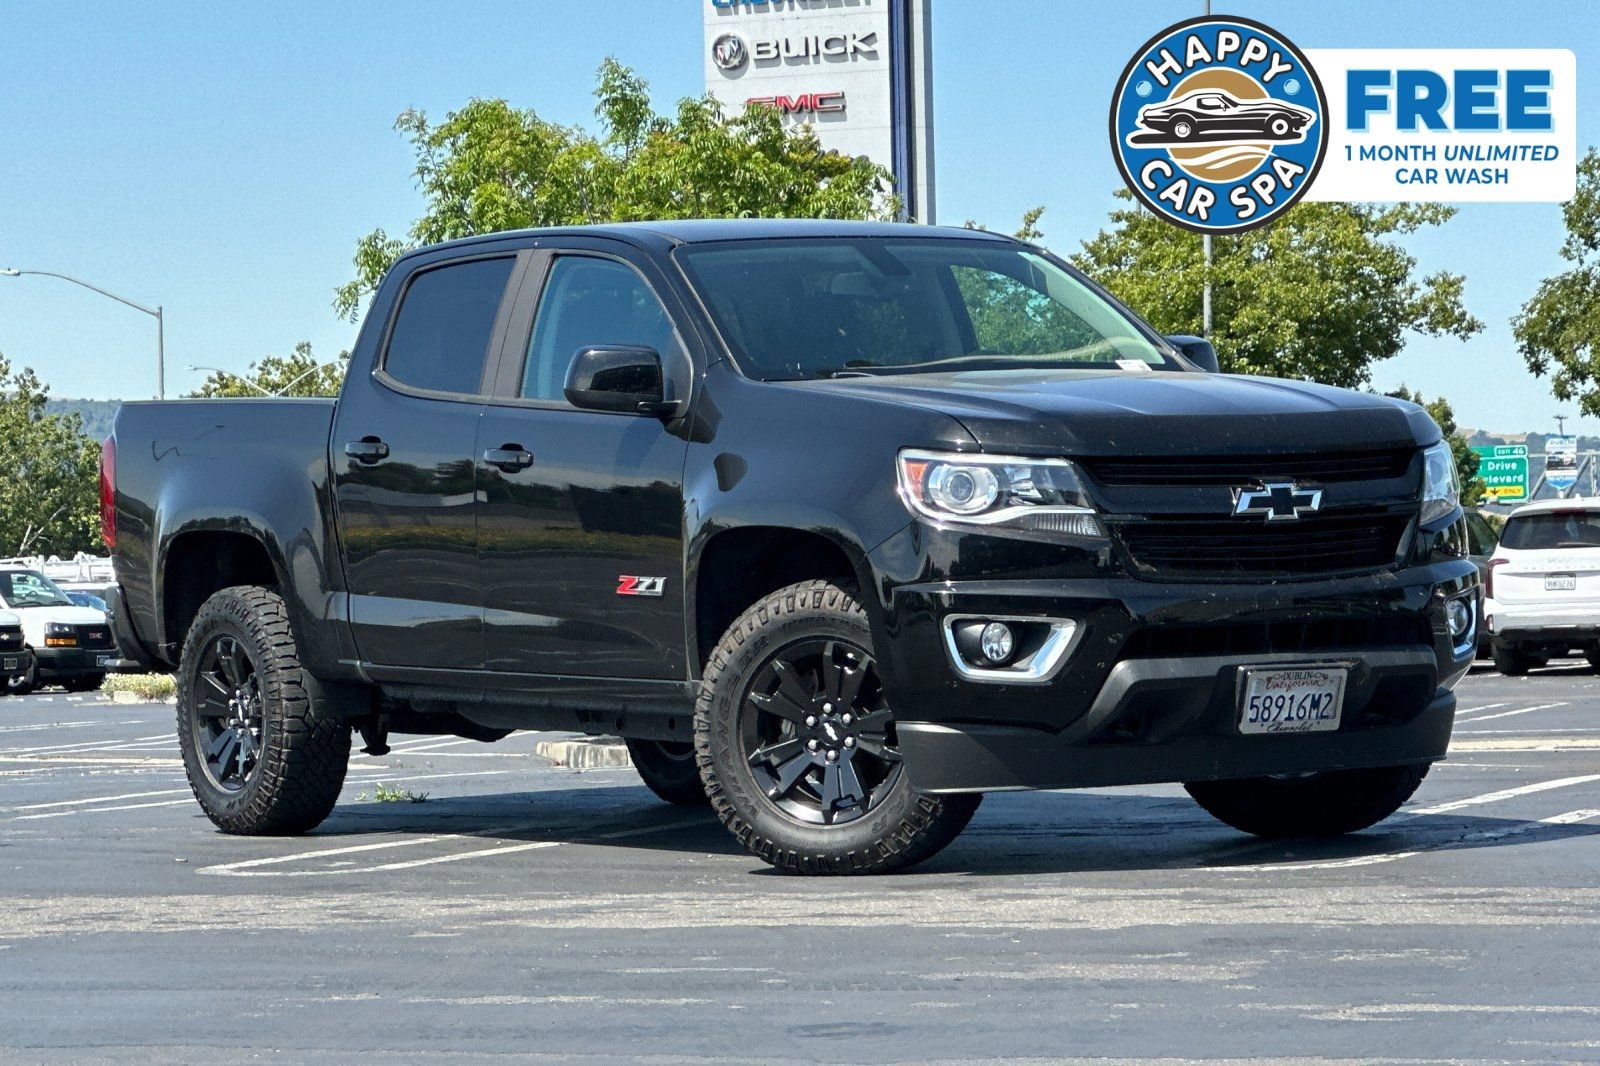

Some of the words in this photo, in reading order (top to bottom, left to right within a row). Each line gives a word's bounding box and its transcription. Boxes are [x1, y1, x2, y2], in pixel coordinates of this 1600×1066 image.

[755, 32, 878, 60] BUICK
[1512, 447, 1525, 455] 46
[1487, 461, 1517, 471] Drive
[617, 575, 667, 595] Z71
[1283, 671, 1313, 681] DUBLIN
[1249, 693, 1334, 723] 58916M2
